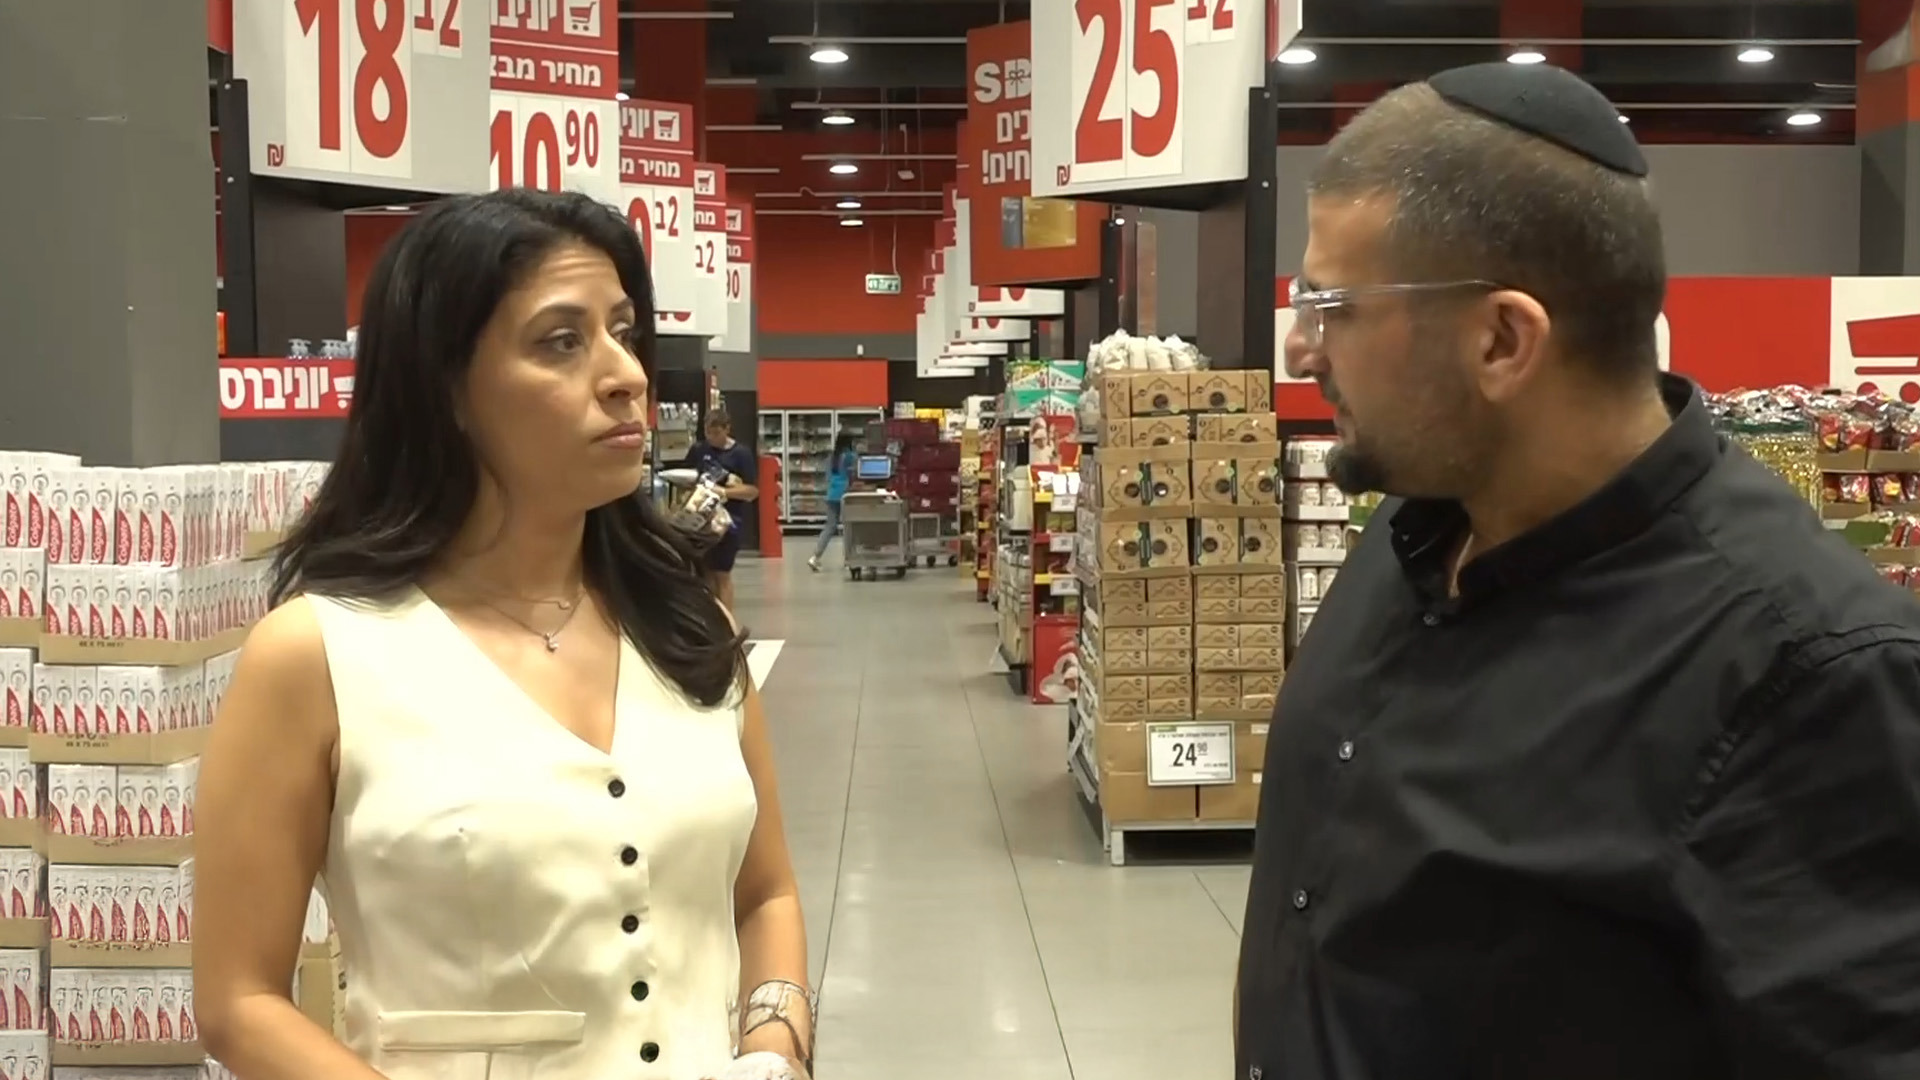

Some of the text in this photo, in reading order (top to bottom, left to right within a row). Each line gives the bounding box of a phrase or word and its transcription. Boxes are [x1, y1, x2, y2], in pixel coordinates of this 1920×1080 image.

[294, 0, 408, 158] 18
[541, 59, 601, 87] מחיר
[1075, 0, 1179, 164] 25
[566, 109, 599, 168] 90
[637, 158, 680, 179] מחיר
[727, 269, 740, 299] 0
[219, 366, 330, 410] יוניברס
[7, 502, 18, 546] Colgate
[29, 502, 41, 546] Colgate
[49, 518, 60, 562] Colgate
[71, 518, 82, 562] Colgate
[118, 520, 129, 564] Colgate
[1172, 742, 1197, 767] 24
